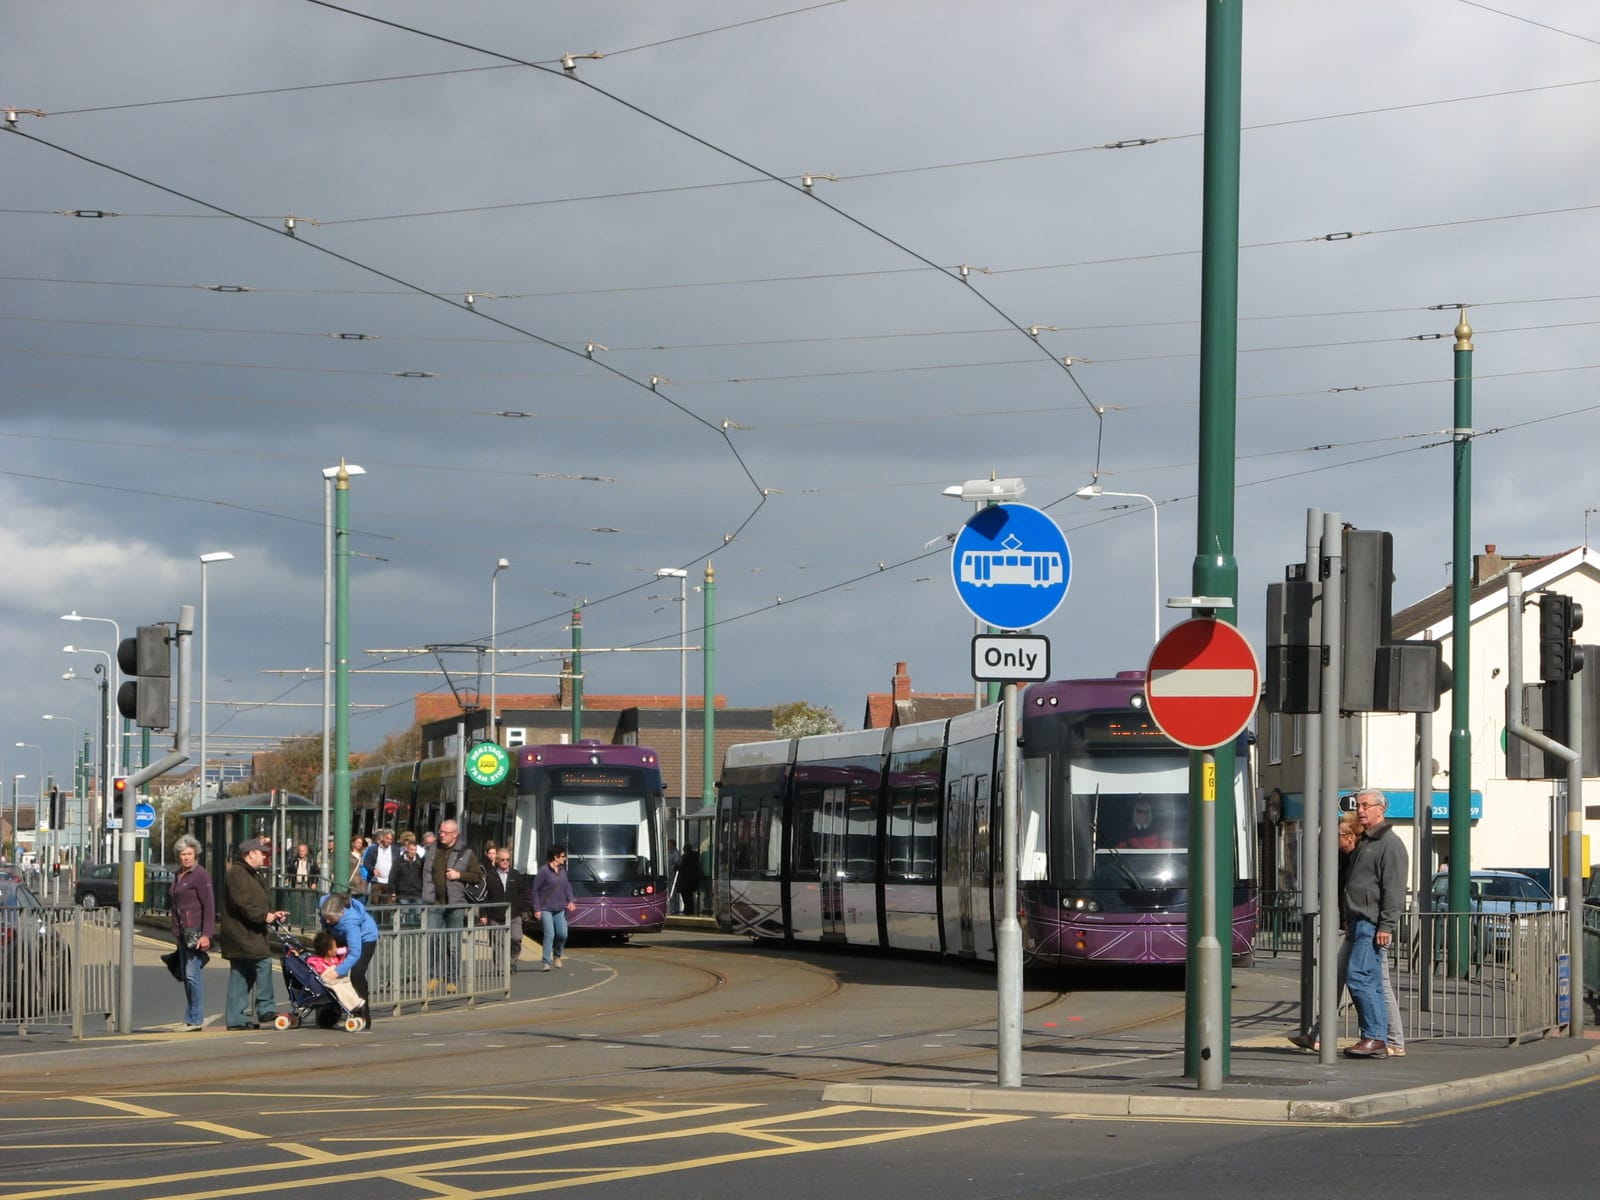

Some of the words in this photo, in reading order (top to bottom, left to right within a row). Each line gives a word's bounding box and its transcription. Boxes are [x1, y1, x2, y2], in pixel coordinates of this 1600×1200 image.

[985, 647, 1037, 671] Only
[471, 745, 505, 760] HERITAGE
[471, 766, 488, 782] TRAM
[490, 765, 505, 782] STOP
